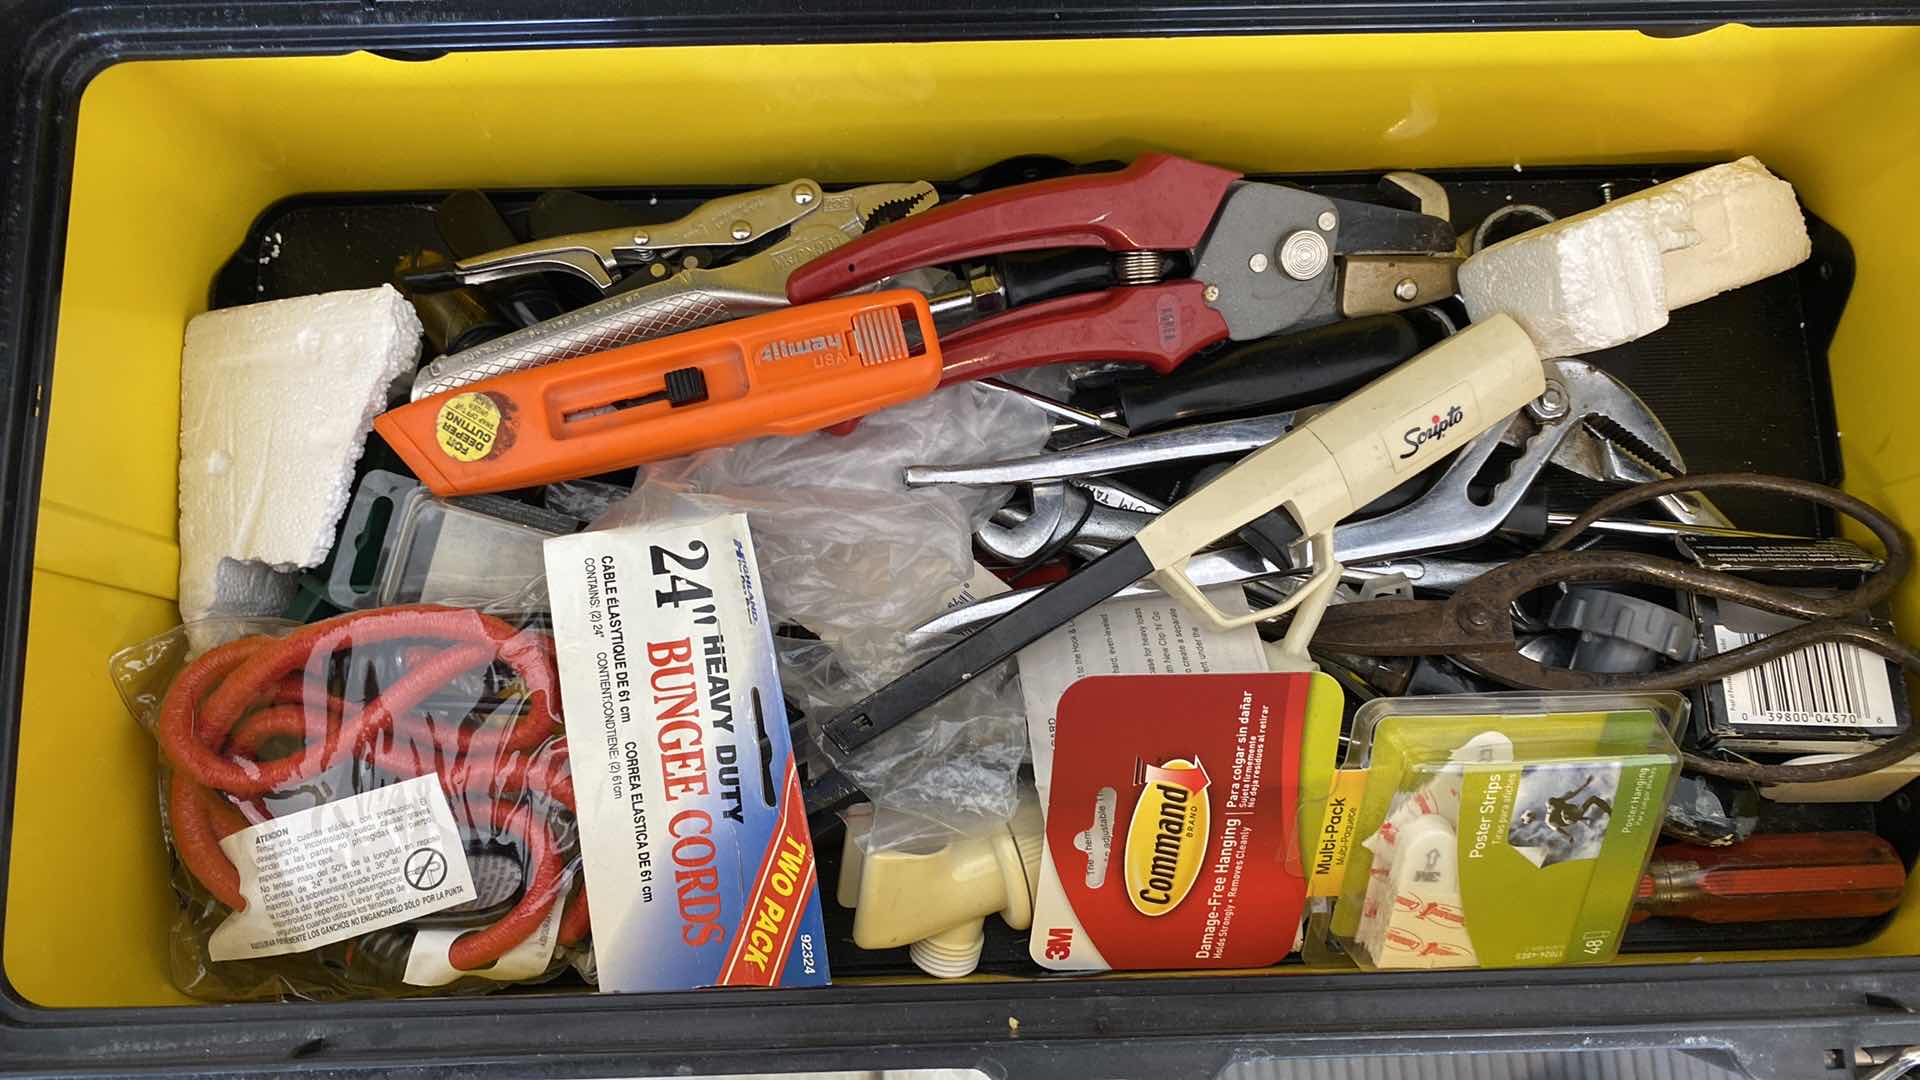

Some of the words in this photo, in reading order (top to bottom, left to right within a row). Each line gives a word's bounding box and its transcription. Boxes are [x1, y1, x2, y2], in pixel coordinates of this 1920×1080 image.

[443, 422, 484, 451] DEEPER
[446, 412, 491, 443] CUTTING
[1400, 404, 1464, 459] Scripto
[446, 436, 469, 455] FOR
[584, 558, 600, 608] CONTAINS:
[601, 555, 617, 595] CÂBLE
[650, 539, 718, 625] 24"
[590, 609, 602, 622] (2)
[593, 623, 605, 639] 24"
[605, 596, 628, 667] ÉLASYTIQUE
[617, 670, 629, 688] DE
[702, 633, 735, 733] HEAVY
[618, 690, 630, 703] 61
[1238, 690, 1252, 724] dañar
[620, 705, 631, 723] cm
[647, 637, 710, 802] BUNGEE
[1259, 704, 1269, 734] retirar
[1741, 712, 1748, 721] 0
[1768, 711, 1809, 722] 39800
[1815, 712, 1857, 724] 04570
[1236, 726, 1248, 743] sin
[1257, 734, 1265, 743] al
[609, 761, 621, 774] (2)
[624, 741, 641, 792] CORREA
[1232, 746, 1246, 780] colgar
[1243, 736, 1257, 782] firmemente
[1253, 744, 1264, 778] residuos
[716, 744, 744, 824] DUTY
[1226, 783, 1240, 808] Para
[1239, 783, 1250, 808] Sujeta
[1250, 780, 1260, 796] deja
[1480, 774, 1501, 813] Strips
[1247, 795, 1256, 808] No
[631, 793, 648, 848] ELASTICA
[1186, 805, 1198, 839] BRAND
[1315, 797, 1346, 875] Multi-Pack
[1469, 816, 1494, 858] Poster
[638, 851, 650, 868] DE
[1139, 784, 1188, 905] Command
[1236, 826, 1252, 860] Cleanly
[640, 869, 652, 884] 61
[668, 809, 726, 948] CORDS
[771, 835, 806, 897] TWO
[1227, 860, 1244, 897] Removes
[643, 885, 653, 903] cm
[1195, 877, 1226, 959] Damage-Free
[1214, 818, 1241, 873] Hanging
[743, 895, 785, 972] PACK
[1219, 904, 1236, 937] Strongly
[800, 933, 815, 975] 92324
[1045, 928, 1073, 961] 3M
[1213, 937, 1226, 959] Holds
[1583, 939, 1604, 955] 48
